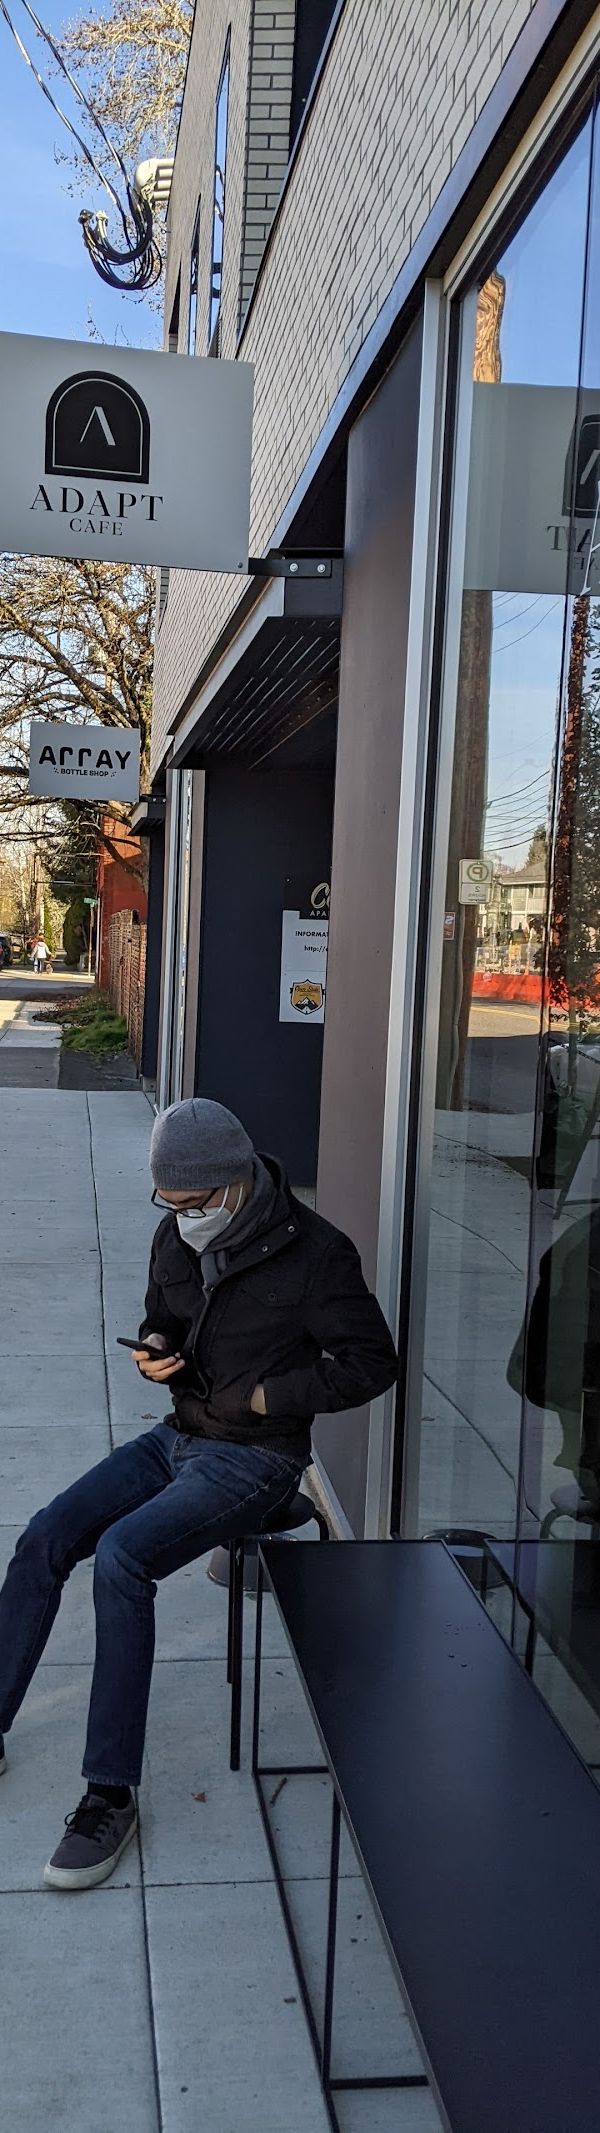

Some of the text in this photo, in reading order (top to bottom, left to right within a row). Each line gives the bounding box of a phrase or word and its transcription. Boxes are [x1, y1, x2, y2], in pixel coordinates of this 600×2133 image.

[29, 484, 164, 521] ADAPT
[69, 518, 123, 536] CAFE
[61, 768, 88, 776] BOTTLE
